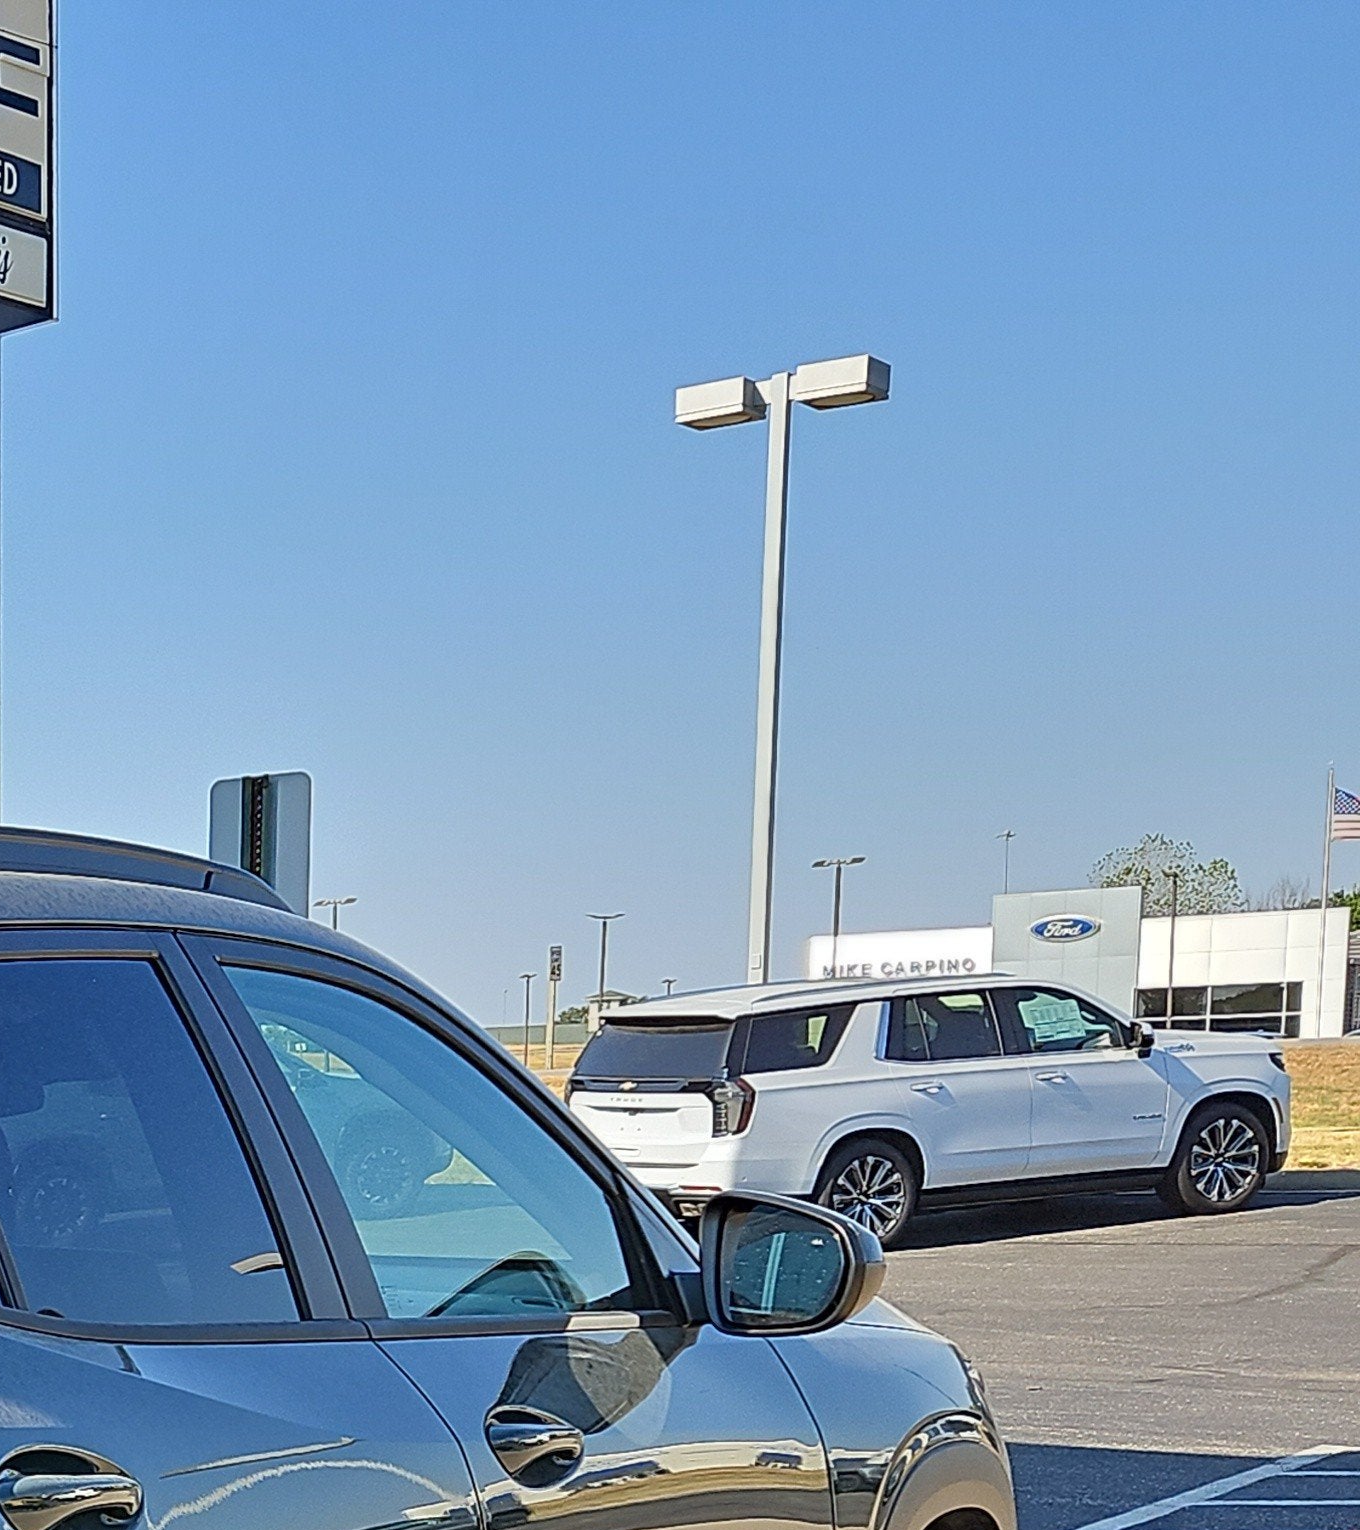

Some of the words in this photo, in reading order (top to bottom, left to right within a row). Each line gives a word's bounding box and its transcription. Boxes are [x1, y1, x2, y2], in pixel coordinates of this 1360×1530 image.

[1043, 920, 1084, 938] Ford
[822, 963, 873, 979] MIKE
[880, 957, 977, 978] CARPINO
